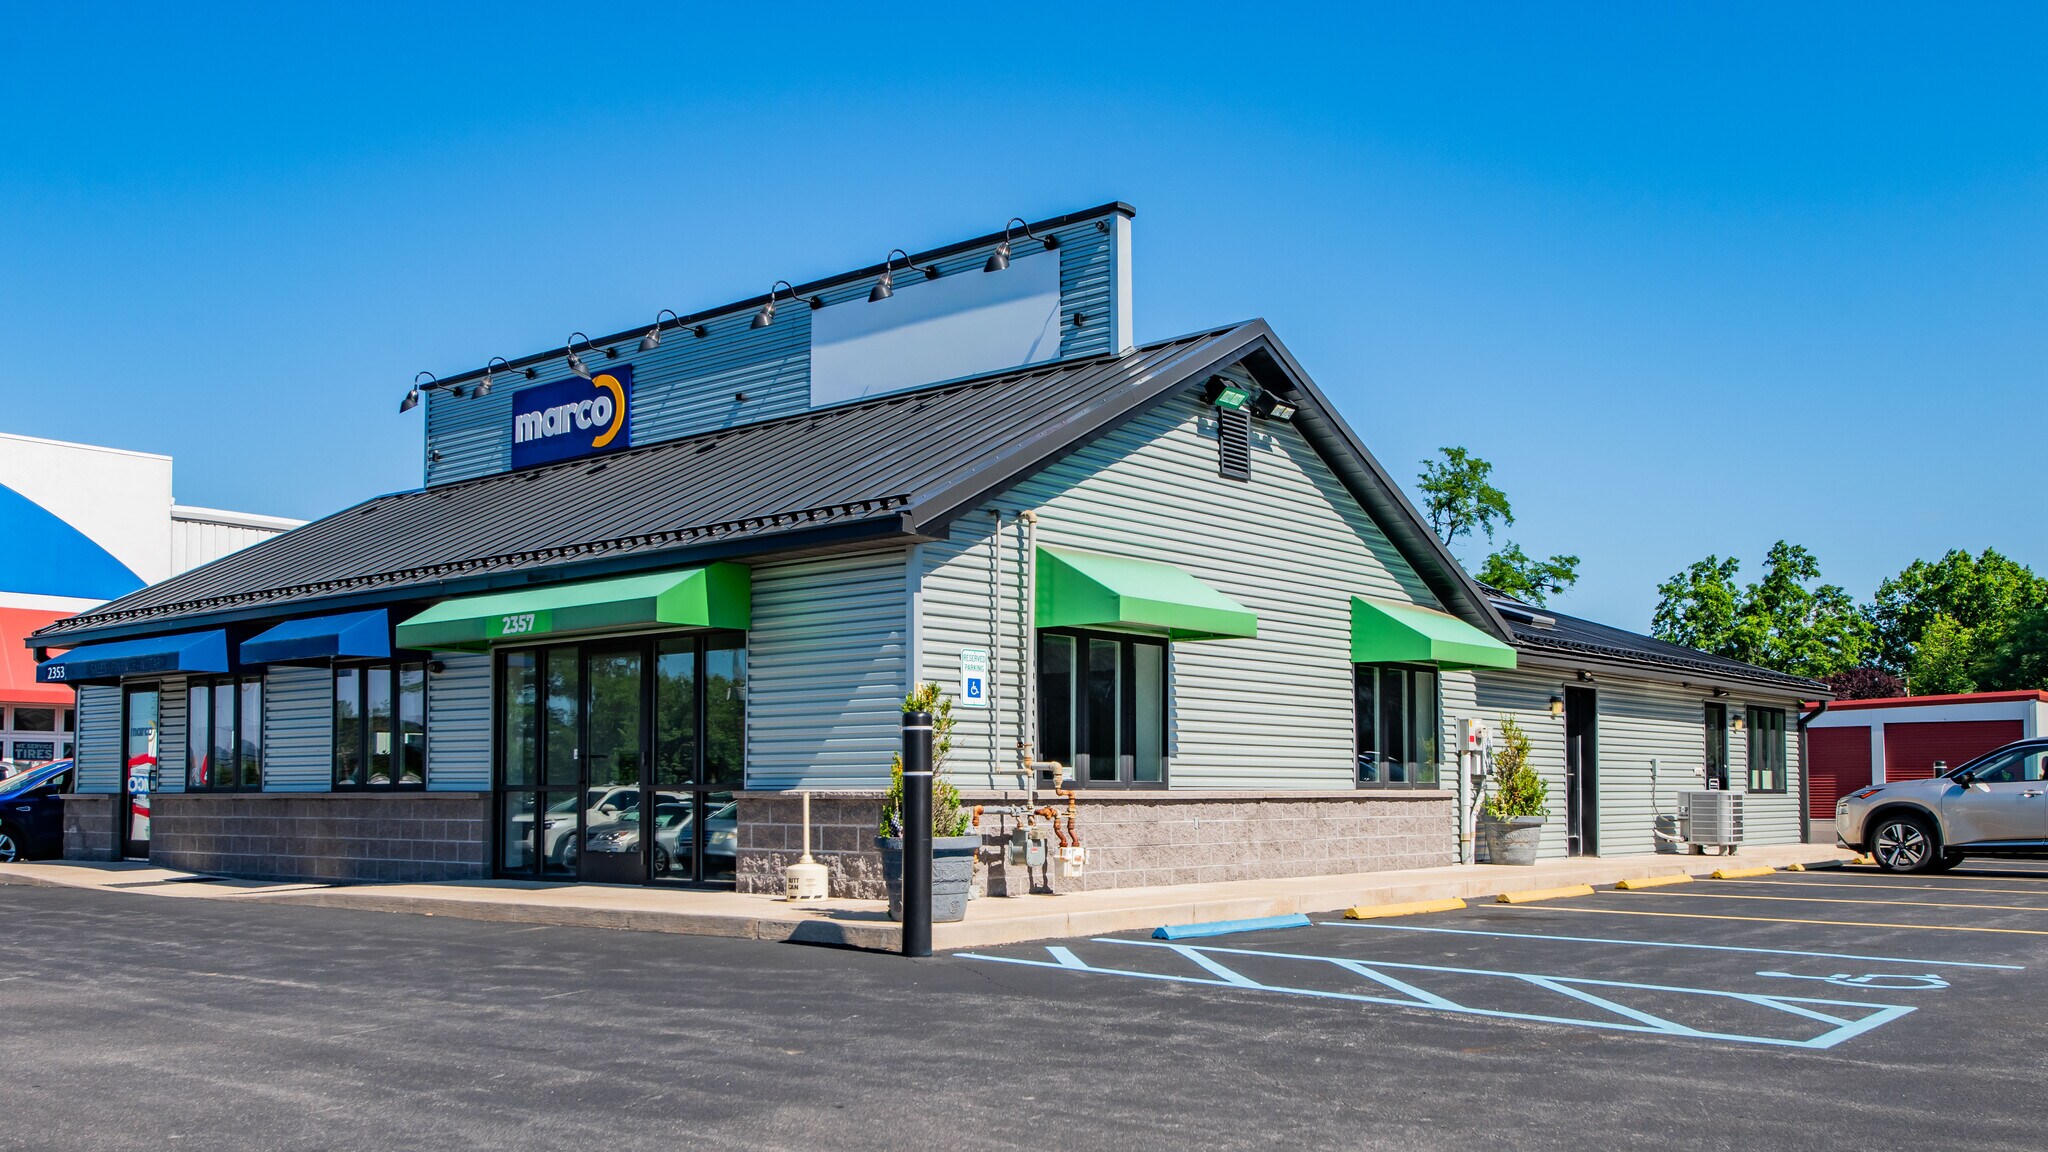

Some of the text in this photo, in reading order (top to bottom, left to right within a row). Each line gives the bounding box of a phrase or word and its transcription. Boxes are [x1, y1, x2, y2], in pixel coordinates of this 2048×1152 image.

[515, 396, 612, 443] marco
[502, 613, 535, 634] 2357
[963, 653, 986, 663] RESERVED
[47, 666, 65, 679] 2353
[965, 664, 984, 672] PARKING
[15, 749, 53, 759] TIRES
